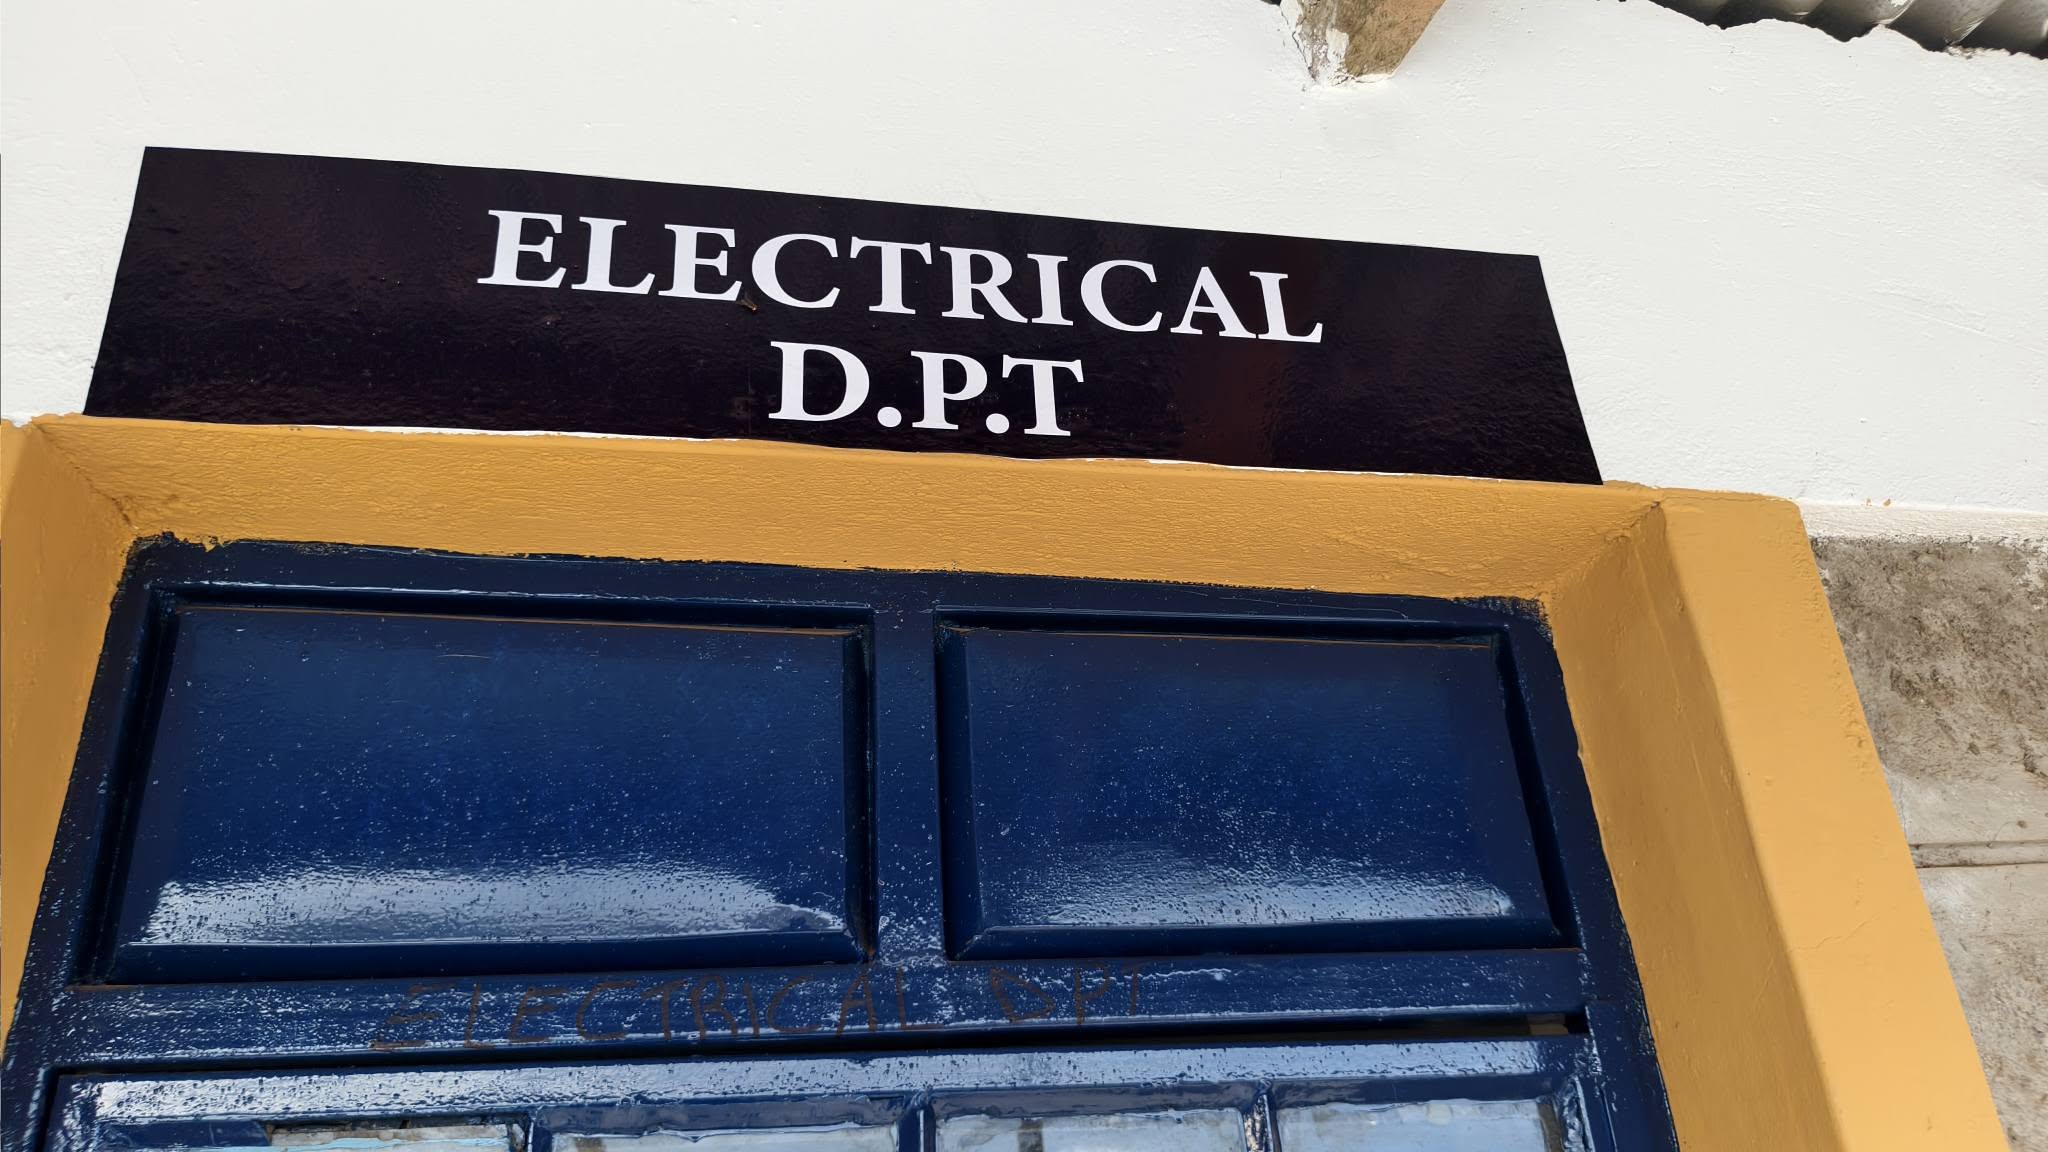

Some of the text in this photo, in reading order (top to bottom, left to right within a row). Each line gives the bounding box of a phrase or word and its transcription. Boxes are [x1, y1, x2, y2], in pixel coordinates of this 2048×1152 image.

[477, 208, 1324, 344] ELECTRICAL
[768, 341, 1085, 438] D.P.T
[368, 960, 1154, 1051] ELECTRICAL DPT
